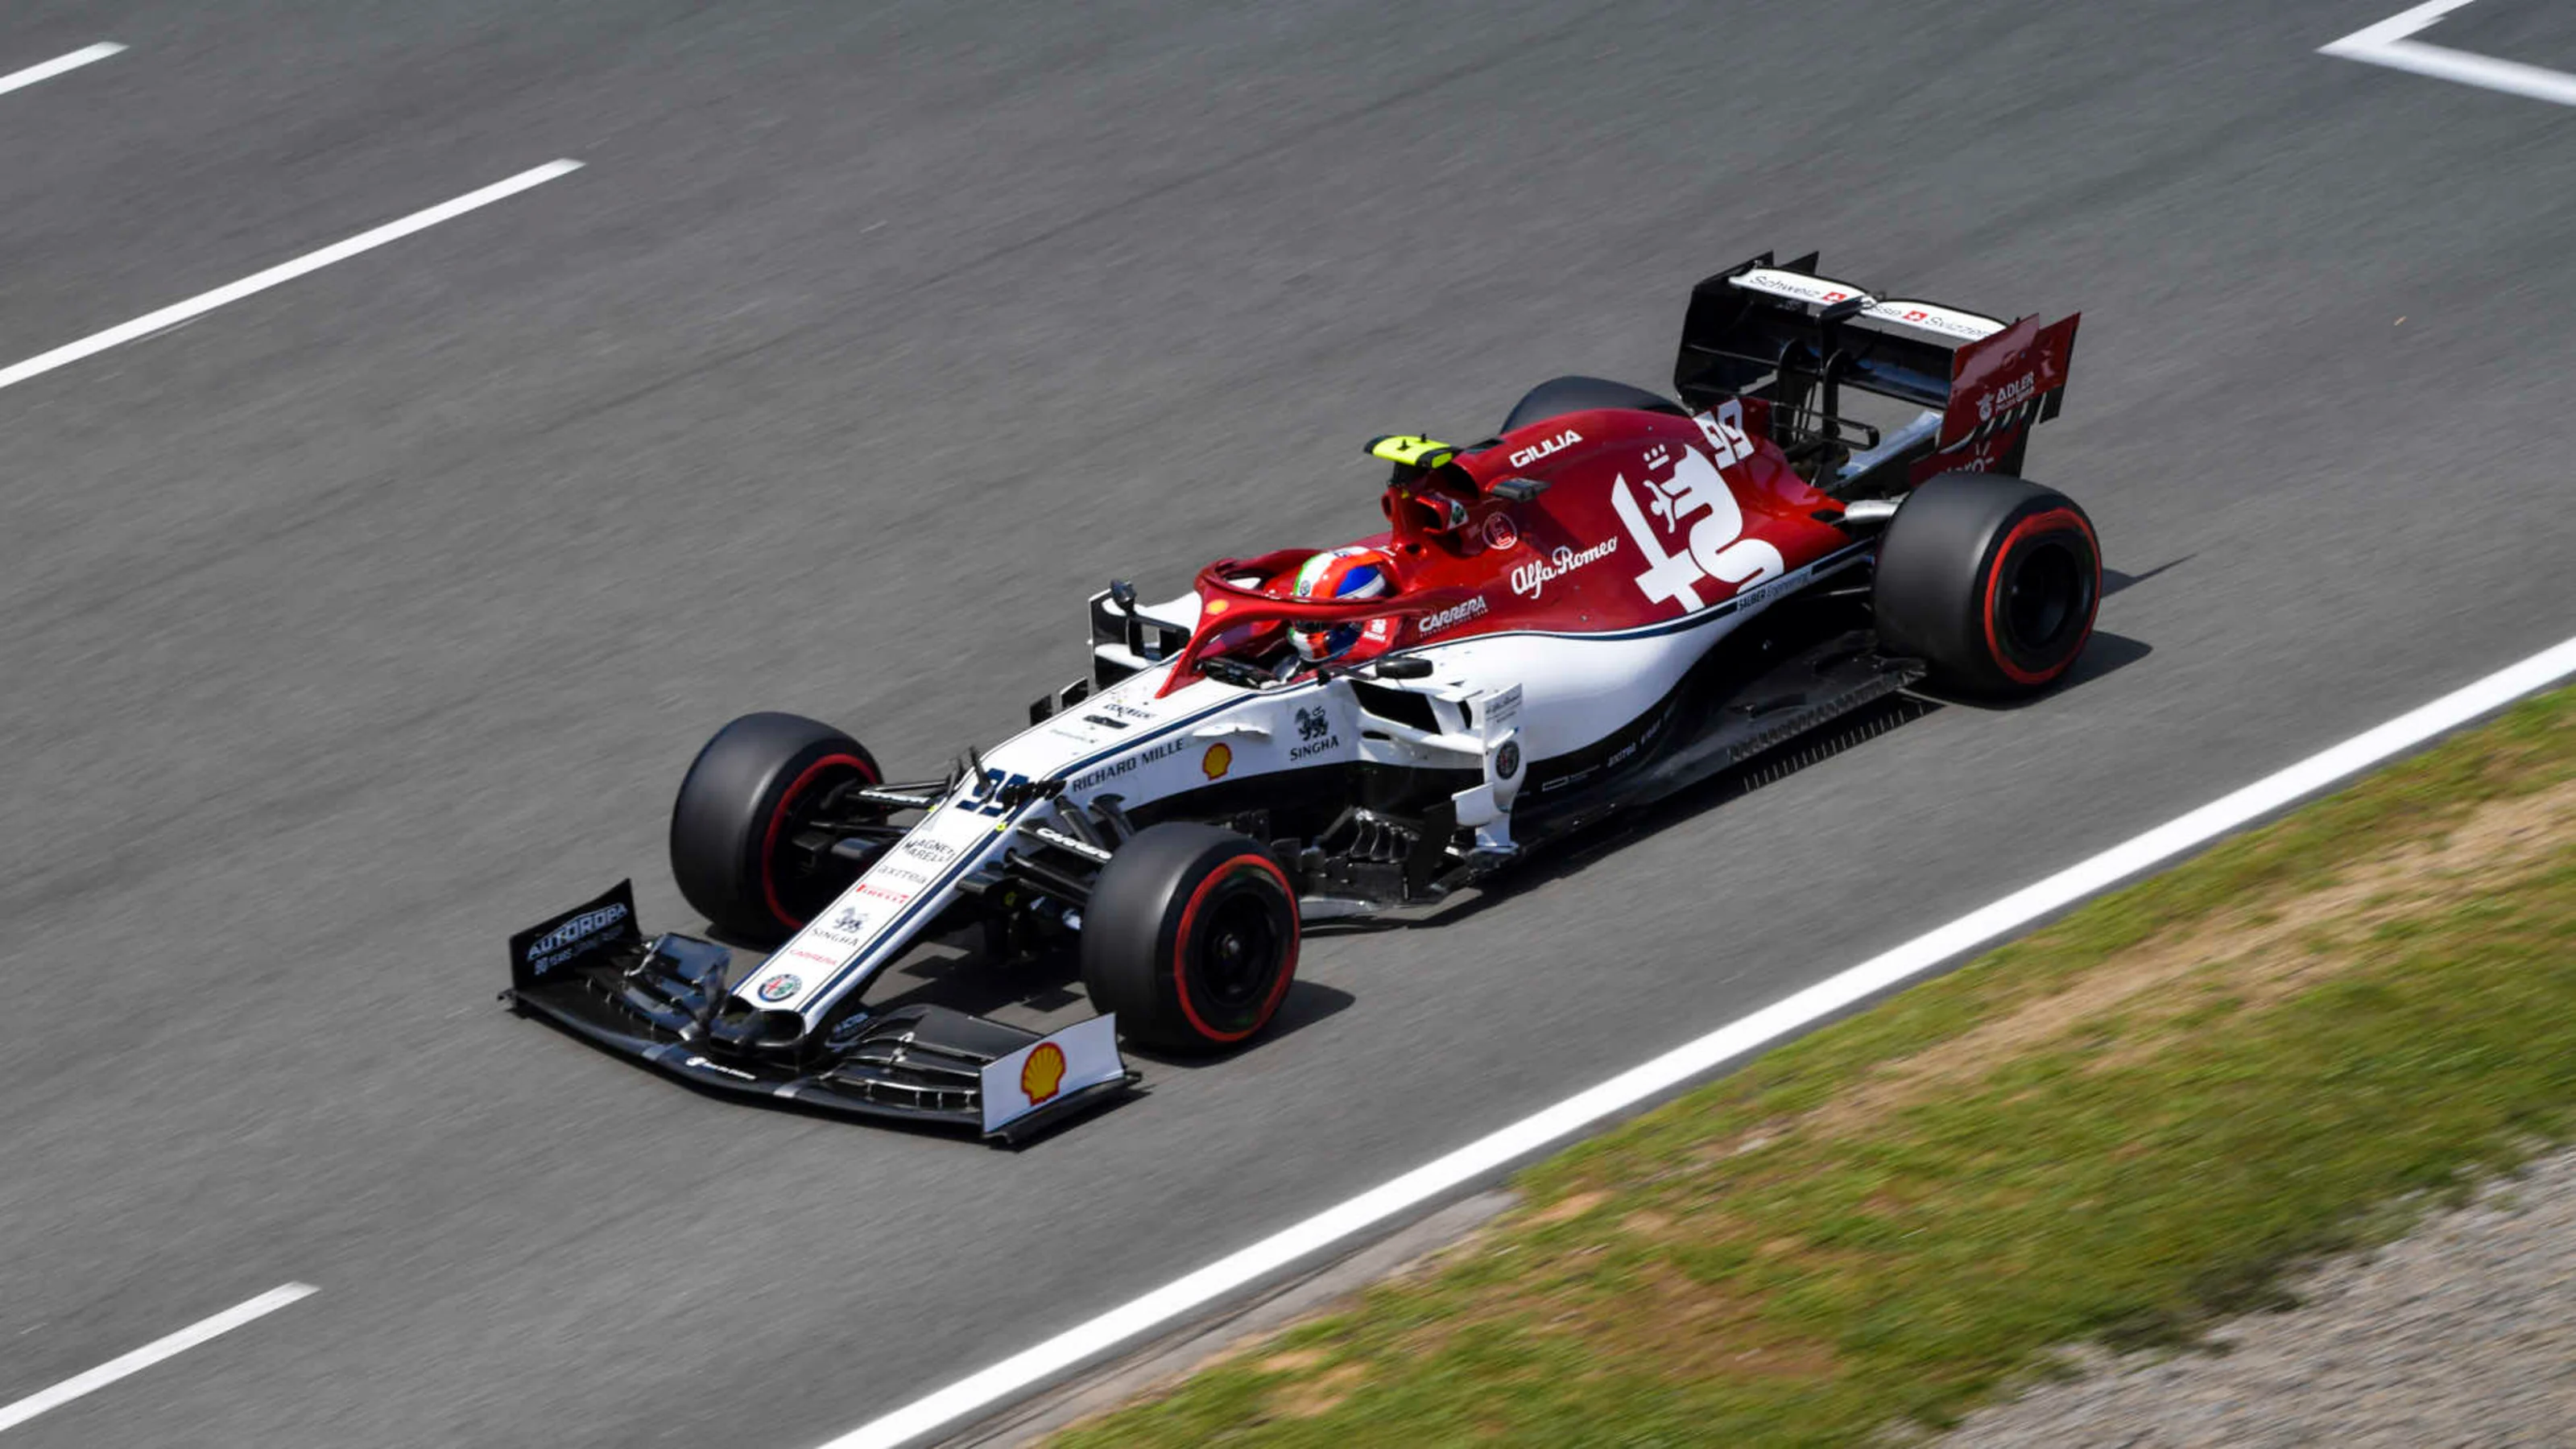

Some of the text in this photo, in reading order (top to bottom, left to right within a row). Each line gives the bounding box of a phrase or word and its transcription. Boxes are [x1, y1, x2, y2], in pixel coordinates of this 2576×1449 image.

[1996, 370, 2034, 405] ADLER
[1509, 428, 1583, 468] GIULIA
[1693, 398, 1755, 470] 99
[1511, 535, 1619, 600] Alfa Romeo
[1419, 594, 1487, 632] CARRERA
[1073, 737, 1184, 792] RICHARD MILLE
[1290, 734, 1339, 762] SINGHA
[527, 901, 628, 962] AUTOROPA
[812, 927, 858, 947] SINGHA
